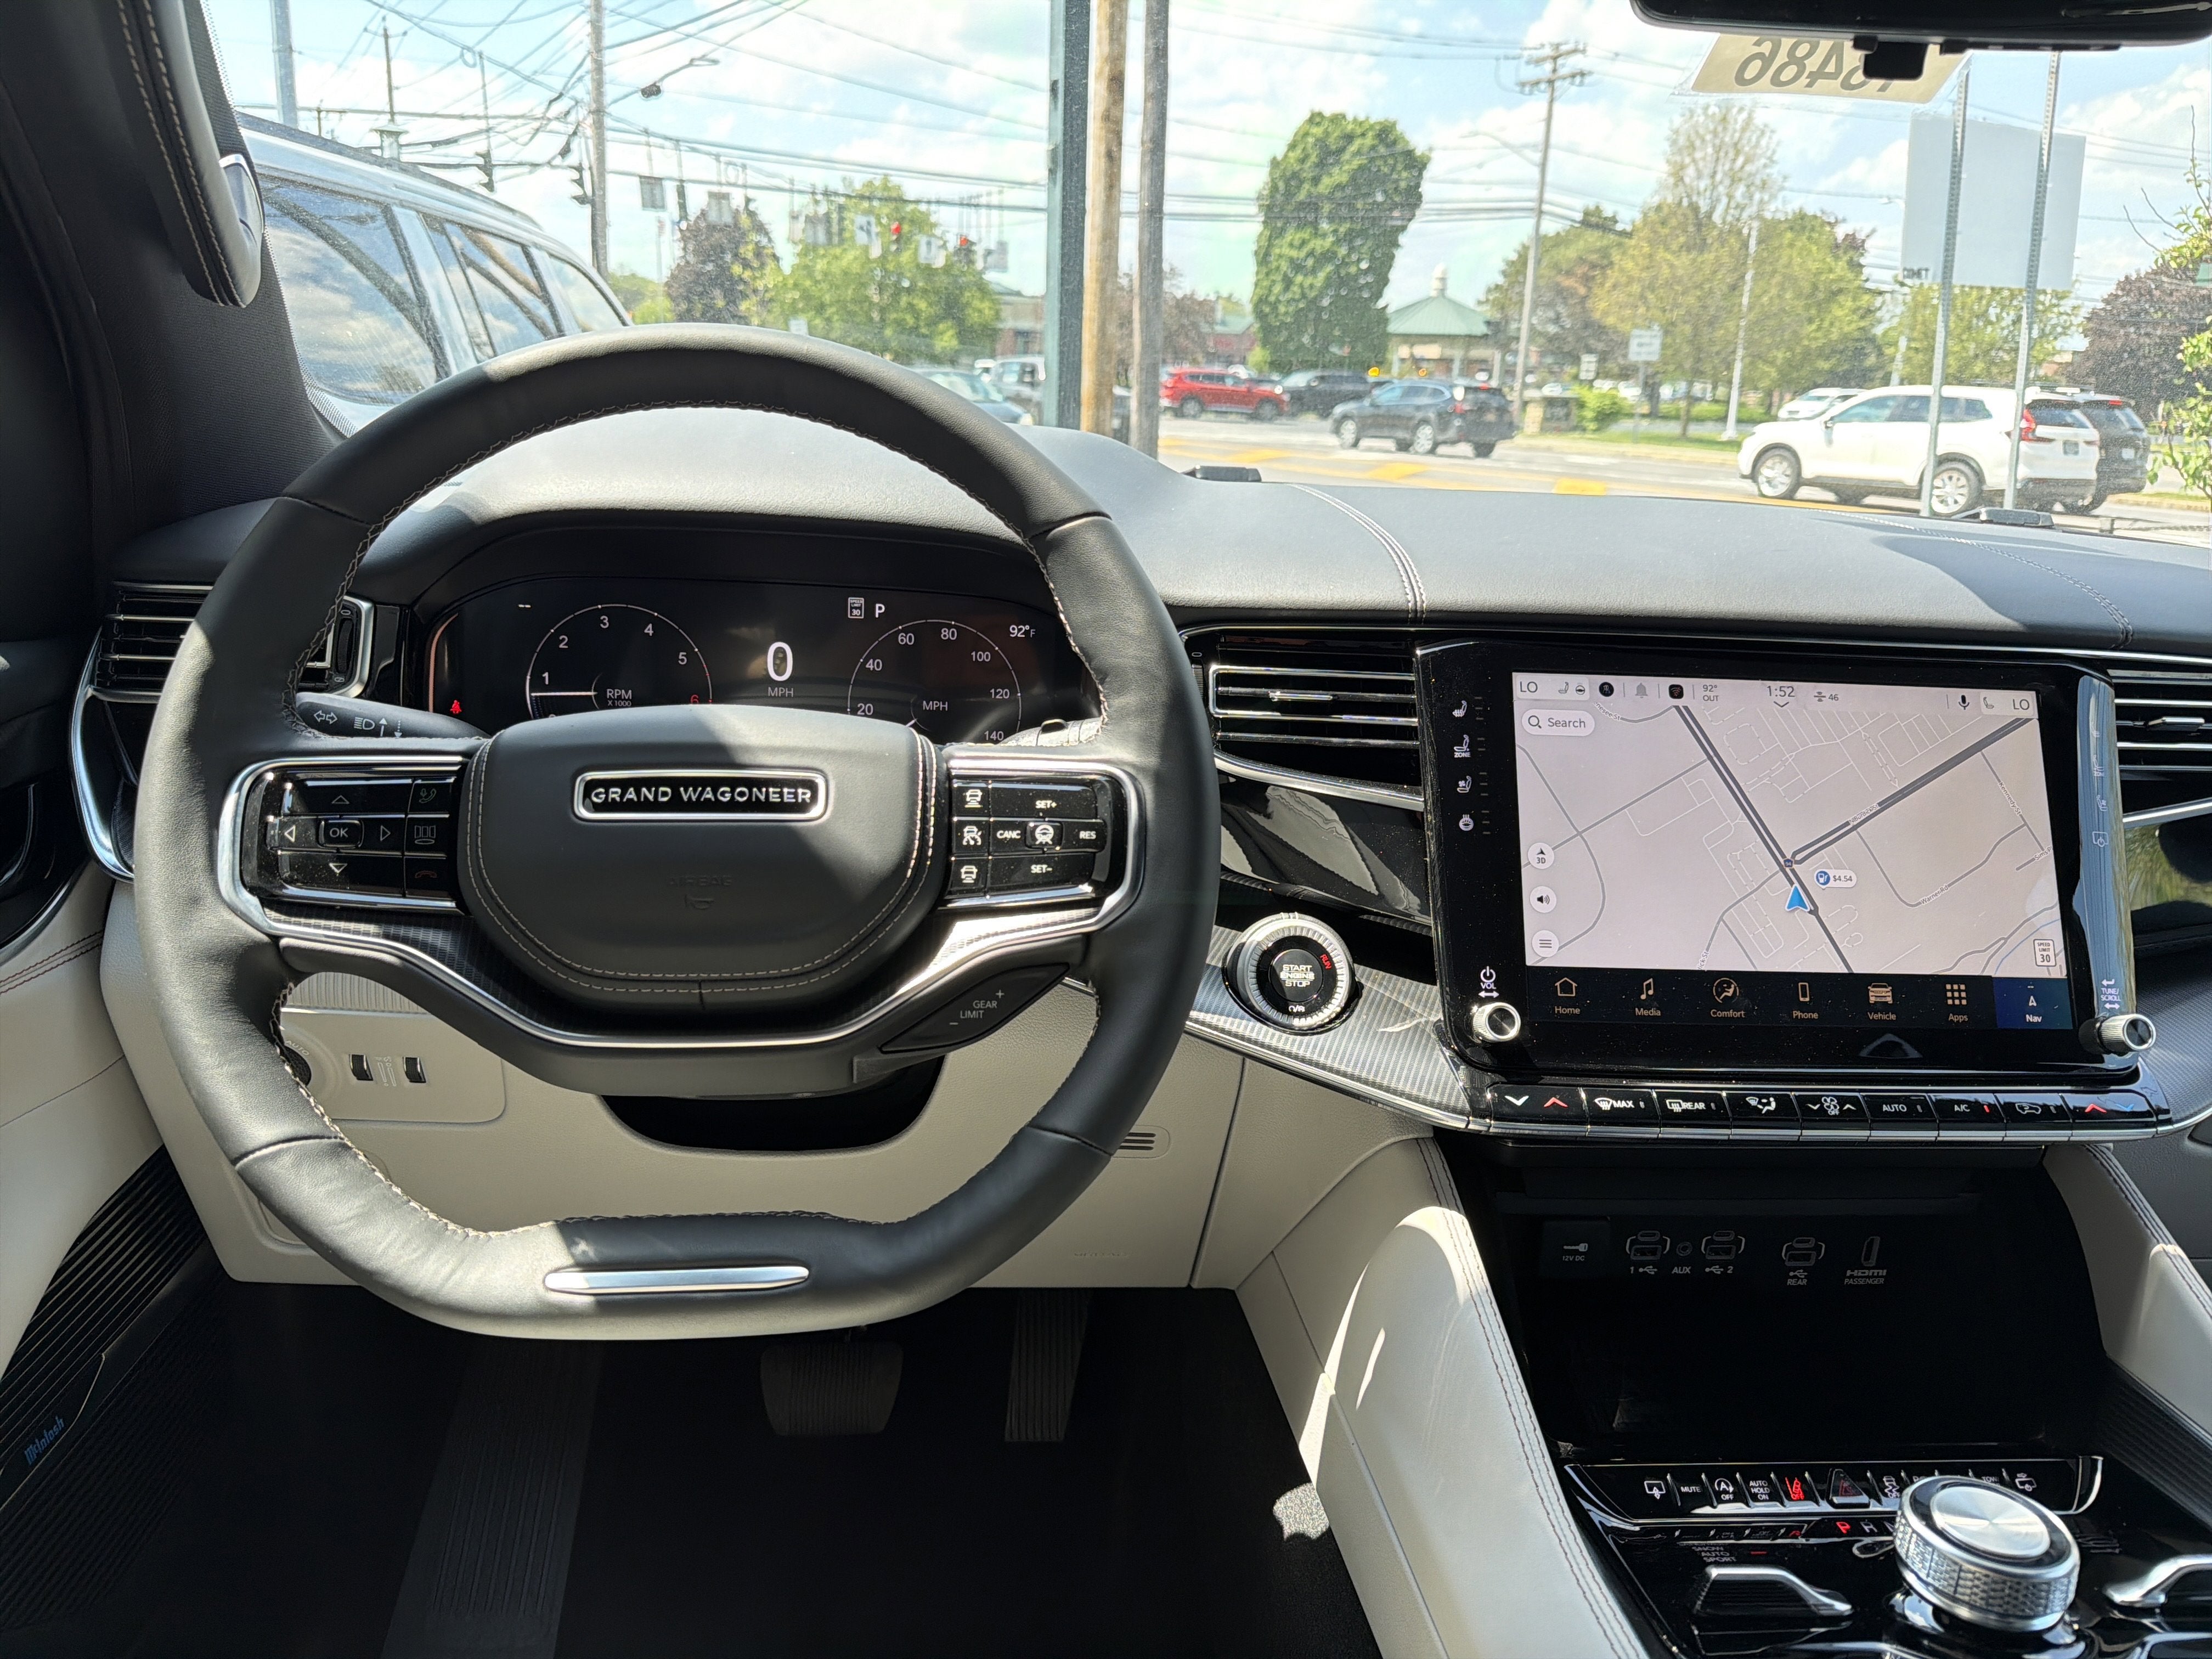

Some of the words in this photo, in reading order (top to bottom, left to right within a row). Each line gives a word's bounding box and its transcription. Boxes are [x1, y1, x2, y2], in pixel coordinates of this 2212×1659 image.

[875, 603, 885, 618] P
[600, 616, 610, 628] 3
[644, 624, 654, 636] 4
[941, 628, 957, 640] 80
[558, 635, 568, 648] 2
[898, 633, 915, 645] 60
[678, 652, 687, 665] 5
[767, 642, 793, 681] 0
[971, 651, 991, 662] 100
[865, 659, 883, 671] 40
[542, 672, 549, 685] 1
[768, 687, 794, 697] MPH
[1520, 681, 1538, 693] LO
[1702, 684, 1718, 692] 92°
[1767, 685, 1796, 697] 1:52
[607, 689, 631, 699] RPM
[690, 695, 699, 704] 6
[990, 689, 1010, 699] 120
[856, 703, 873, 715] 20
[923, 701, 948, 711] MPH
[2013, 698, 2030, 710] LO
[1548, 718, 1586, 729] Search
[984, 730, 1005, 741] 140
[591, 787, 672, 803] GRAND
[680, 787, 812, 803] WAGONEER
[1999, 782, 2016, 808] Kennedy
[1035, 800, 1057, 809] SET+
[329, 827, 348, 838] OK
[996, 830, 1021, 839] CANC
[1079, 831, 1096, 839] RES
[2034, 850, 2048, 861] Sims
[1030, 864, 1053, 873] SET-
[1920, 890, 1940, 904] Warner
[1939, 884, 1948, 893] Rd
[1320, 954, 1332, 969] RUN
[2040, 954, 2051, 963] 30
[1280, 972, 1315, 980] ENGINE
[973, 1000, 997, 1009] GEAR
[1555, 1006, 1581, 1014] Home
[960, 1010, 984, 1019] LIMIT
[1635, 1007, 1661, 1016] Media
[1710, 1009, 1745, 1018] Comfort
[1792, 1011, 1819, 1019] Phone
[1867, 1012, 1897, 1020] Vehicle
[1948, 1013, 1968, 1023] Apps
[2025, 1014, 2042, 1023] Nav
[285, 1040, 309, 1056] AUTO
[1613, 1100, 1635, 1108] MAX
[1683, 1101, 1706, 1110] REAR
[1882, 1104, 1907, 1112] AUTO
[1954, 1104, 1970, 1112] A/C
[1836, 1521, 1851, 1534] P
[1860, 1521, 1878, 1533] R
